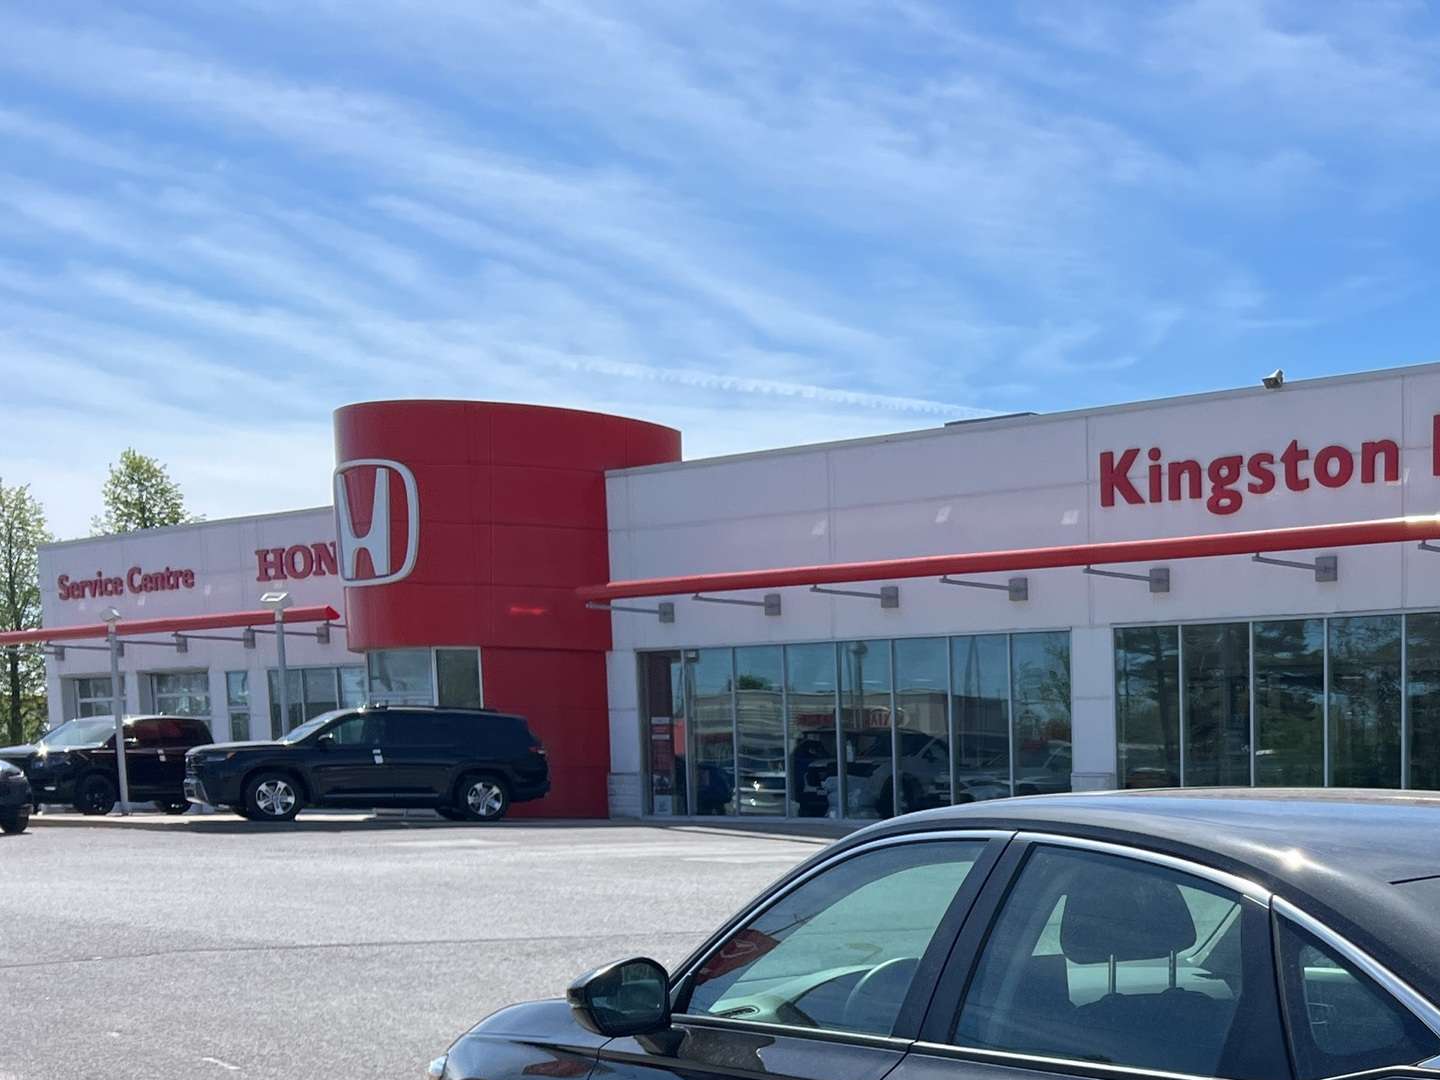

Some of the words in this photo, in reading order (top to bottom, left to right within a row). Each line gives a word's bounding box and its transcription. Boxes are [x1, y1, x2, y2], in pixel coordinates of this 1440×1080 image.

[1100, 435, 1400, 515] Kingston
[255, 541, 337, 582] HON
[59, 570, 124, 601] Service
[126, 566, 195, 594] Centre
